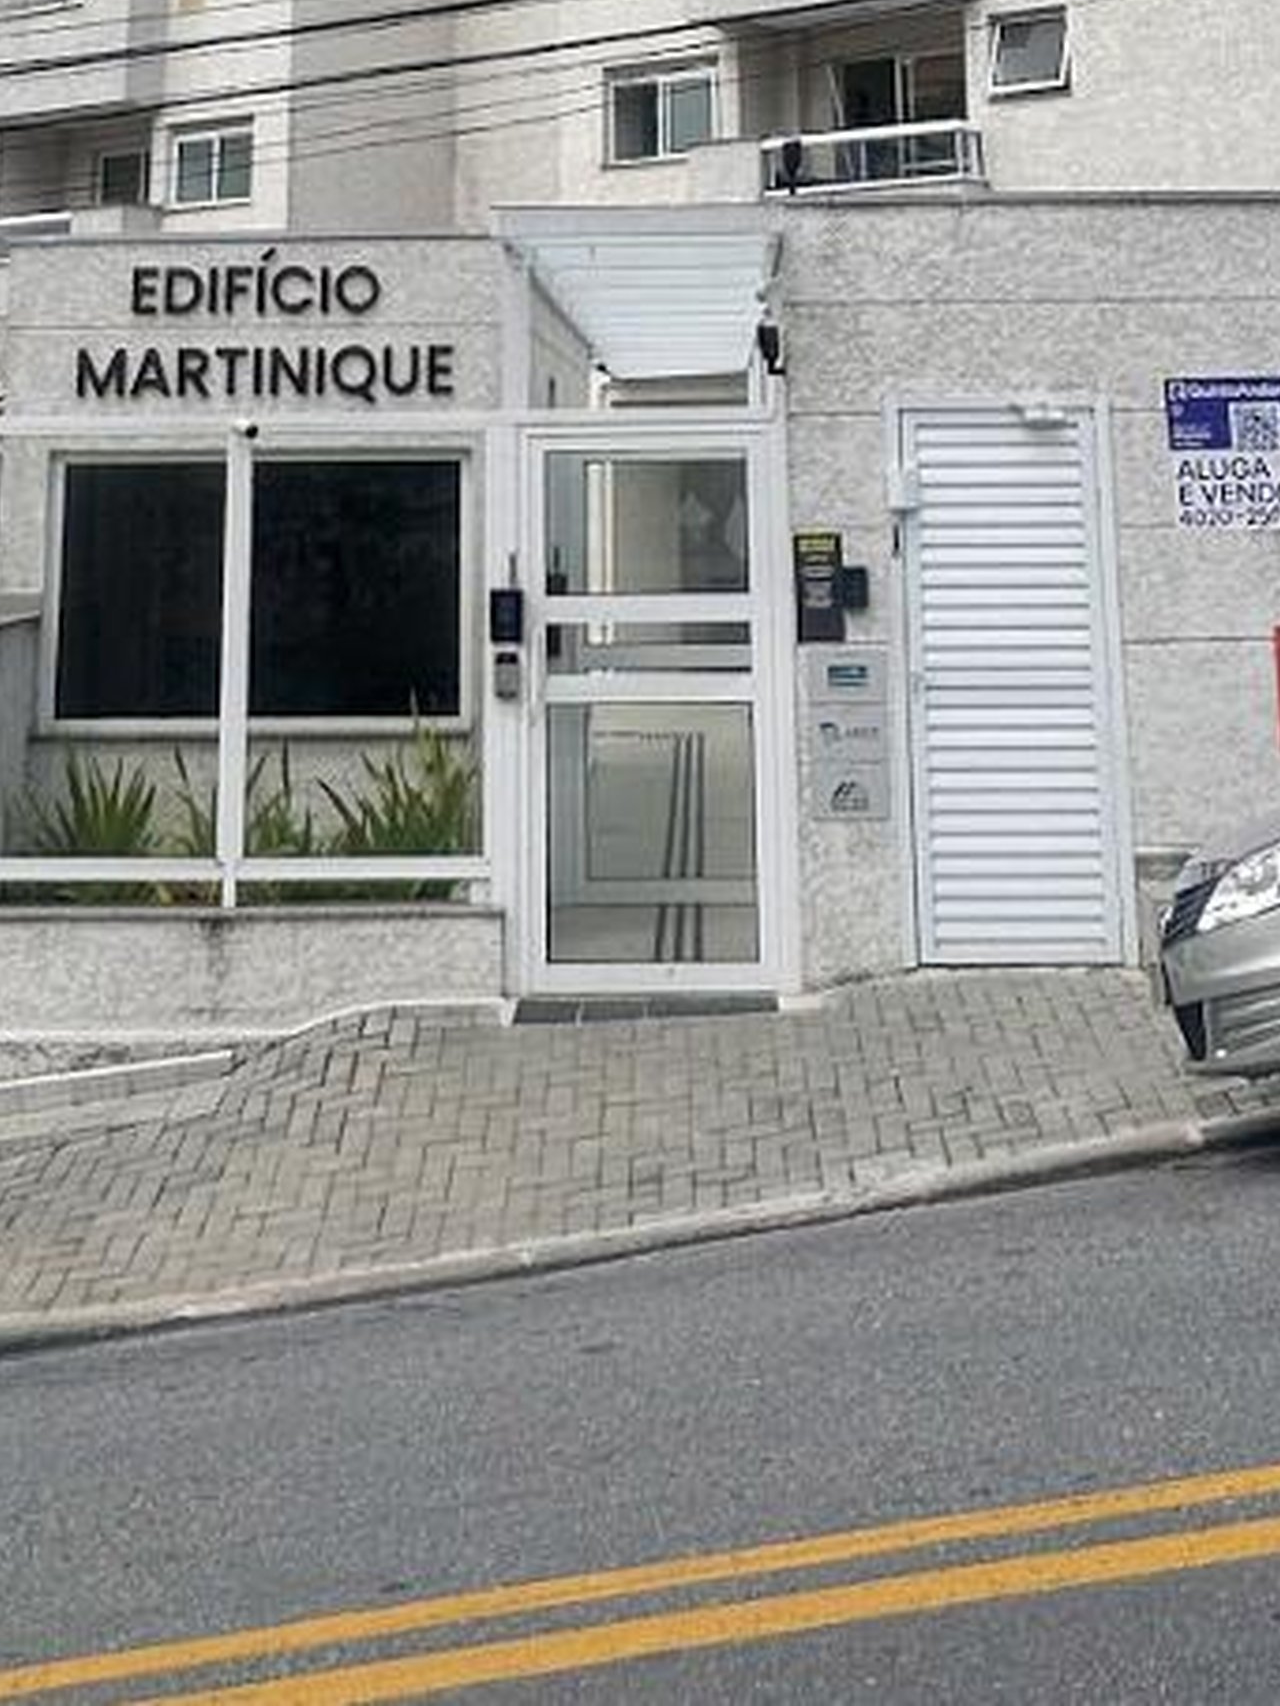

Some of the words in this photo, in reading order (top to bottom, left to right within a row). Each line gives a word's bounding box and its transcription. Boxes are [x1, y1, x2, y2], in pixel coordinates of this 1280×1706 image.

[131, 247, 381, 316] EDIFÍCIO
[75, 344, 455, 404] MARTINIQUE
[1177, 456, 1271, 480] ALUGA
[1179, 484, 1194, 506] E
